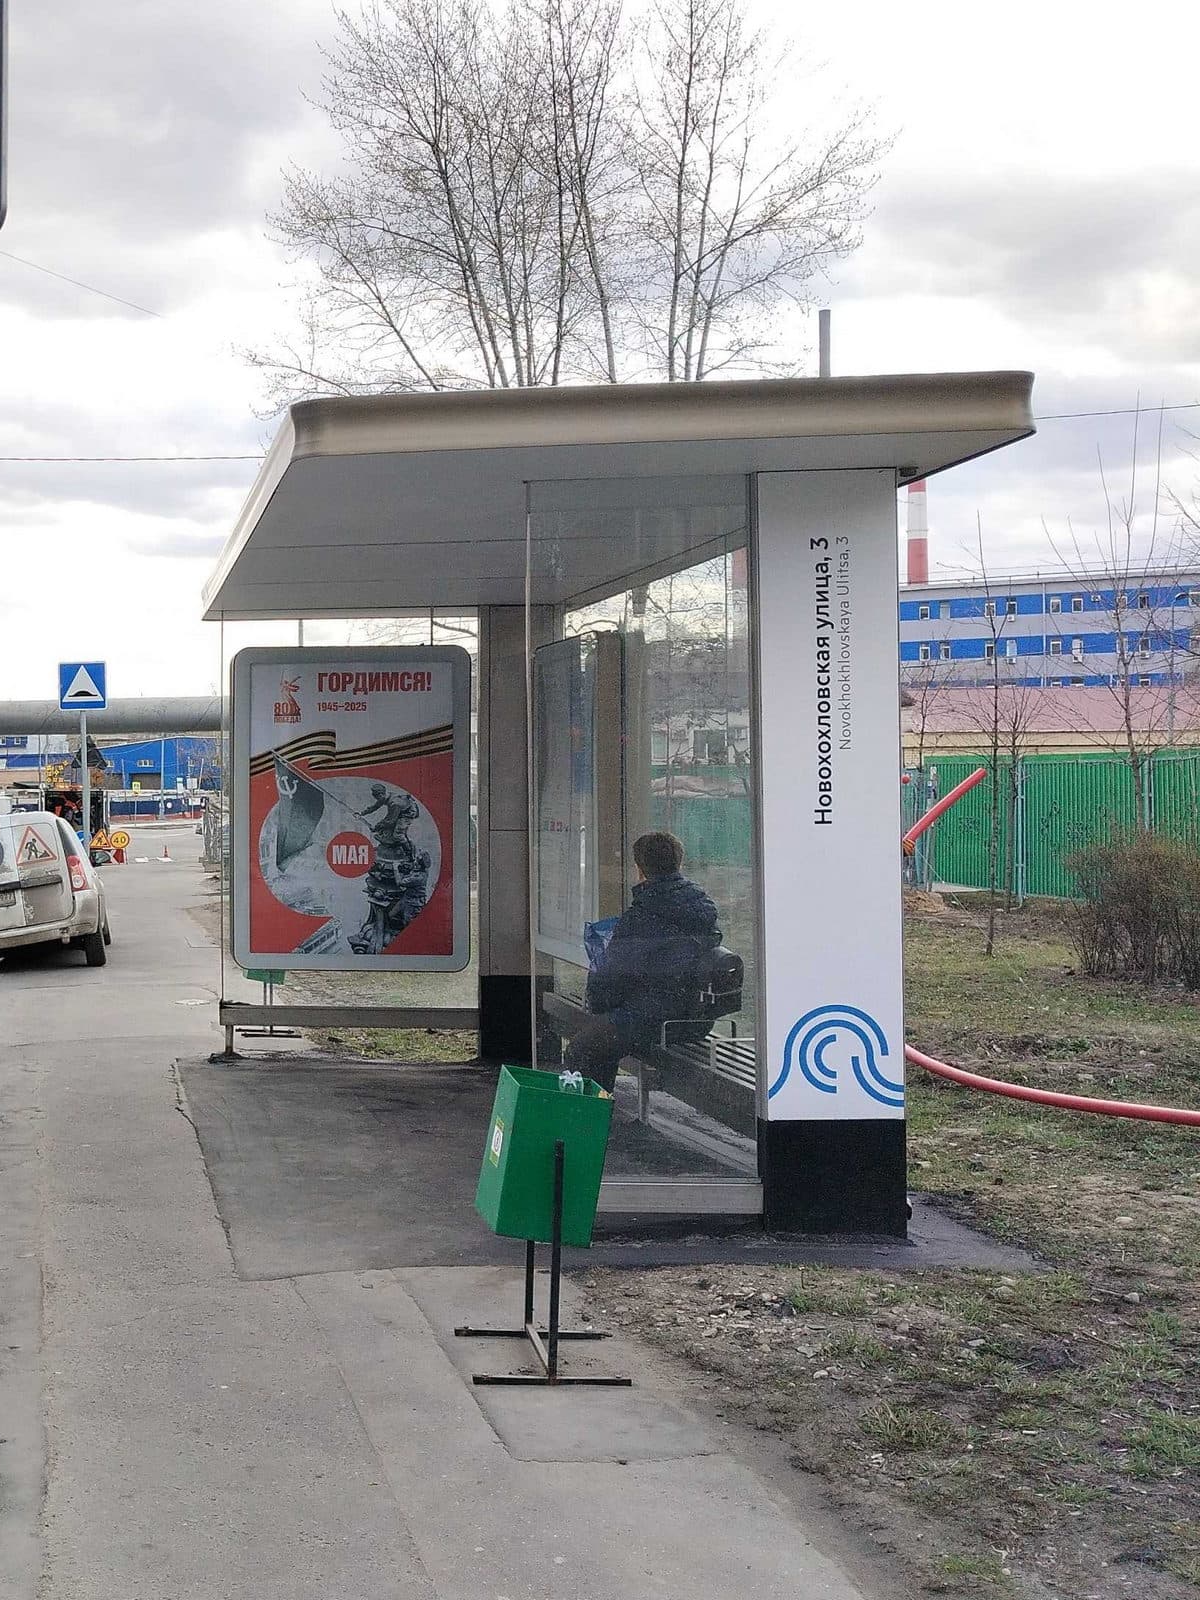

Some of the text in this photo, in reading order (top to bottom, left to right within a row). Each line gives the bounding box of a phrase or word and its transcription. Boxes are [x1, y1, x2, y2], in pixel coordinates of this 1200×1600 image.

[836, 536, 852, 750] Novokhokhlovskaya Ulitsa, 3
[317, 671, 432, 695] ГОРДИМСЯ!
[810, 537, 834, 825] Новохохловская улица, 3
[273, 702, 289, 715] 80
[113, 835, 127, 844] 40
[332, 844, 369, 865] МАЯ
